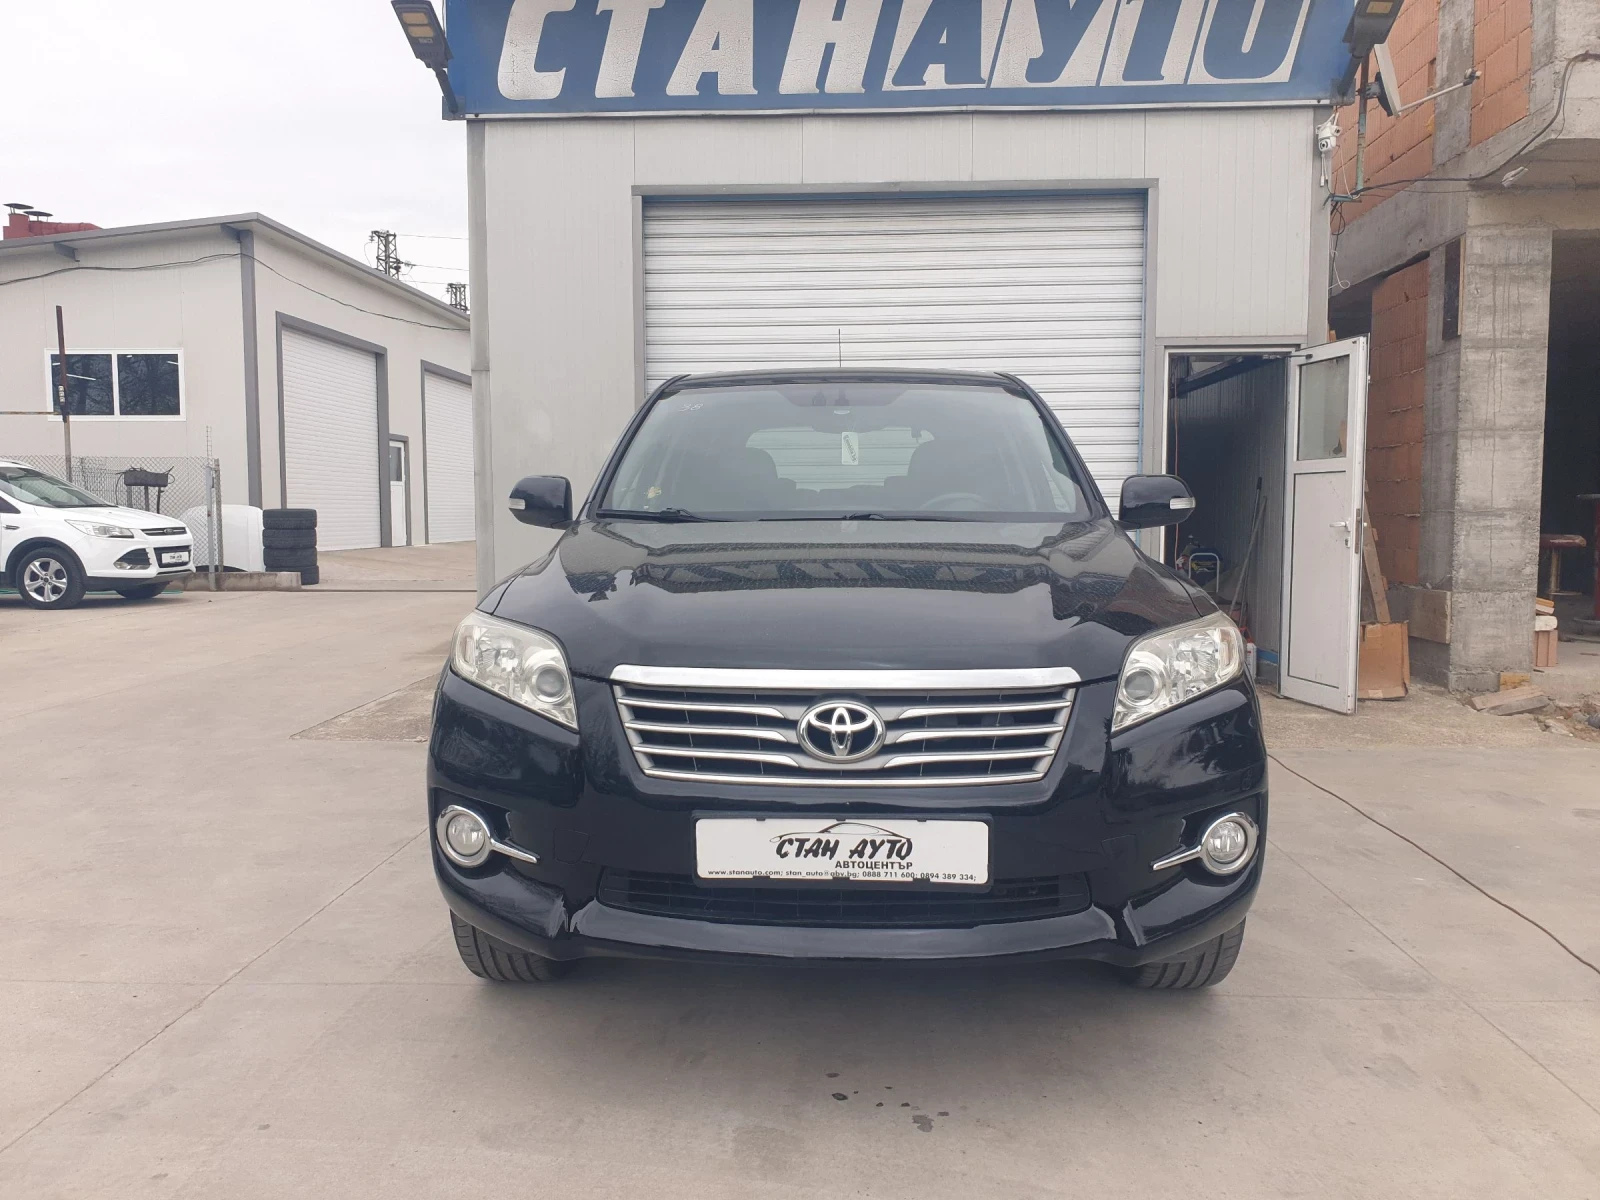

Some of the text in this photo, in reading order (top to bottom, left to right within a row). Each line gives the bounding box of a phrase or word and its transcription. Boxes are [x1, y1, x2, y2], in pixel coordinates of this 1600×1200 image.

[497, 0, 1306, 100] СТАН АУТО
[775, 837, 913, 860] СТАН АУТО
[834, 860, 913, 870] АВТОЦЕНТЪР
[707, 869, 784, 877] www.stanauto.com;
[862, 870, 881, 878] 0888
[920, 872, 940, 880] 0894
[959, 873, 977, 881] 334;
